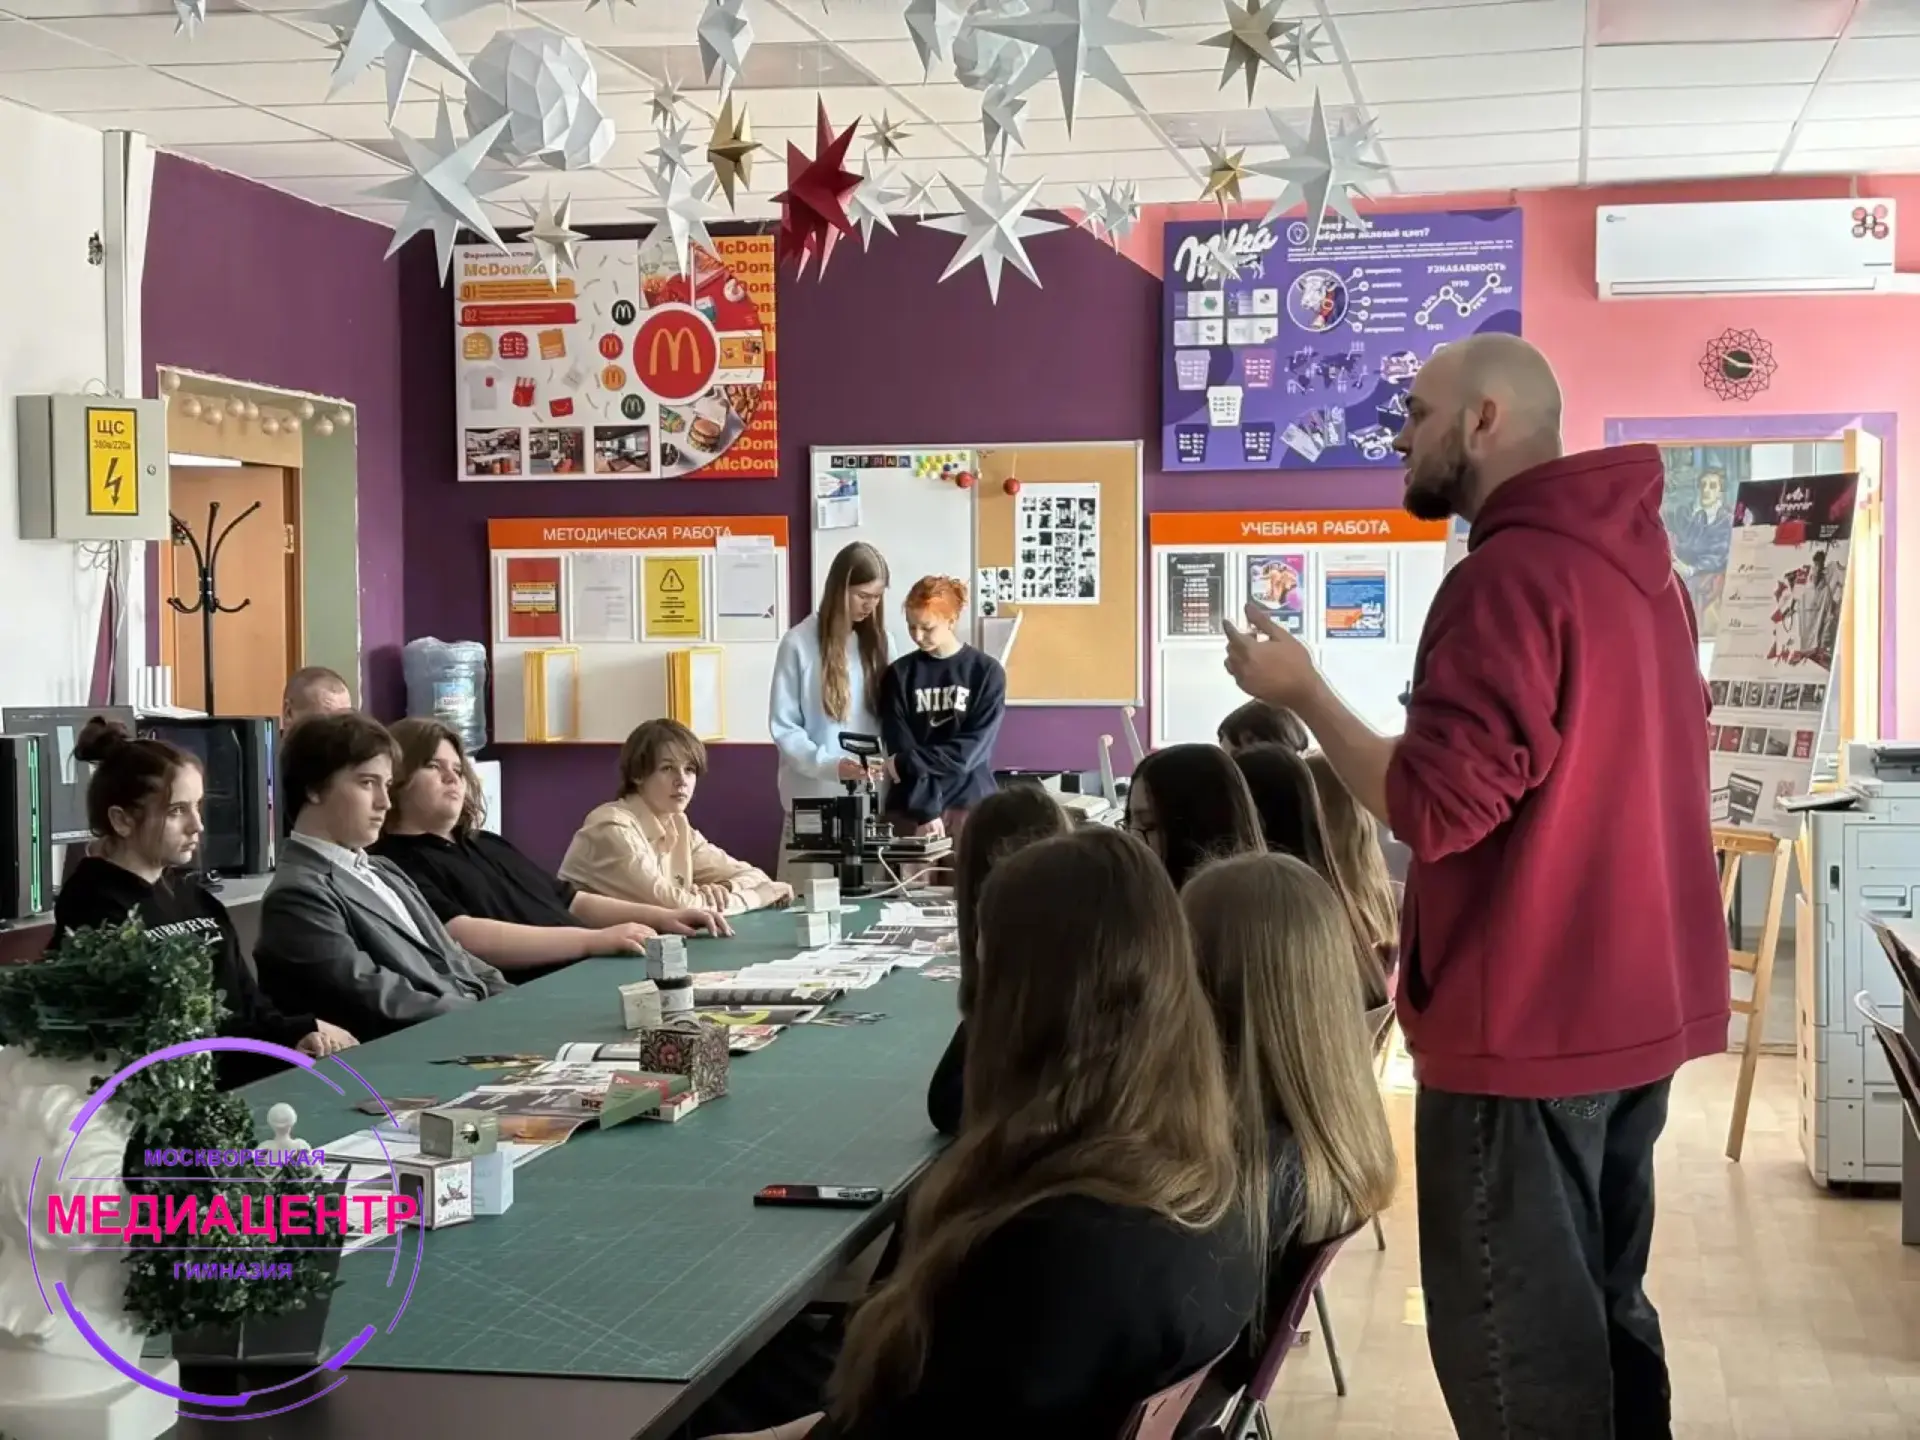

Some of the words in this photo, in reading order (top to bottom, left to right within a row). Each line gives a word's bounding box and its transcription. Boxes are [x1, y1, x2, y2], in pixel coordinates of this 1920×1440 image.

[97, 419, 125, 436] ЩС
[542, 526, 668, 543] МЕТОДИЧЕСКАЯ
[673, 525, 732, 541] РАБОТА
[1240, 520, 1318, 536] УЧЕБНАЯ
[1323, 519, 1391, 535] РАБОТА
[914, 684, 970, 713] NIKE
